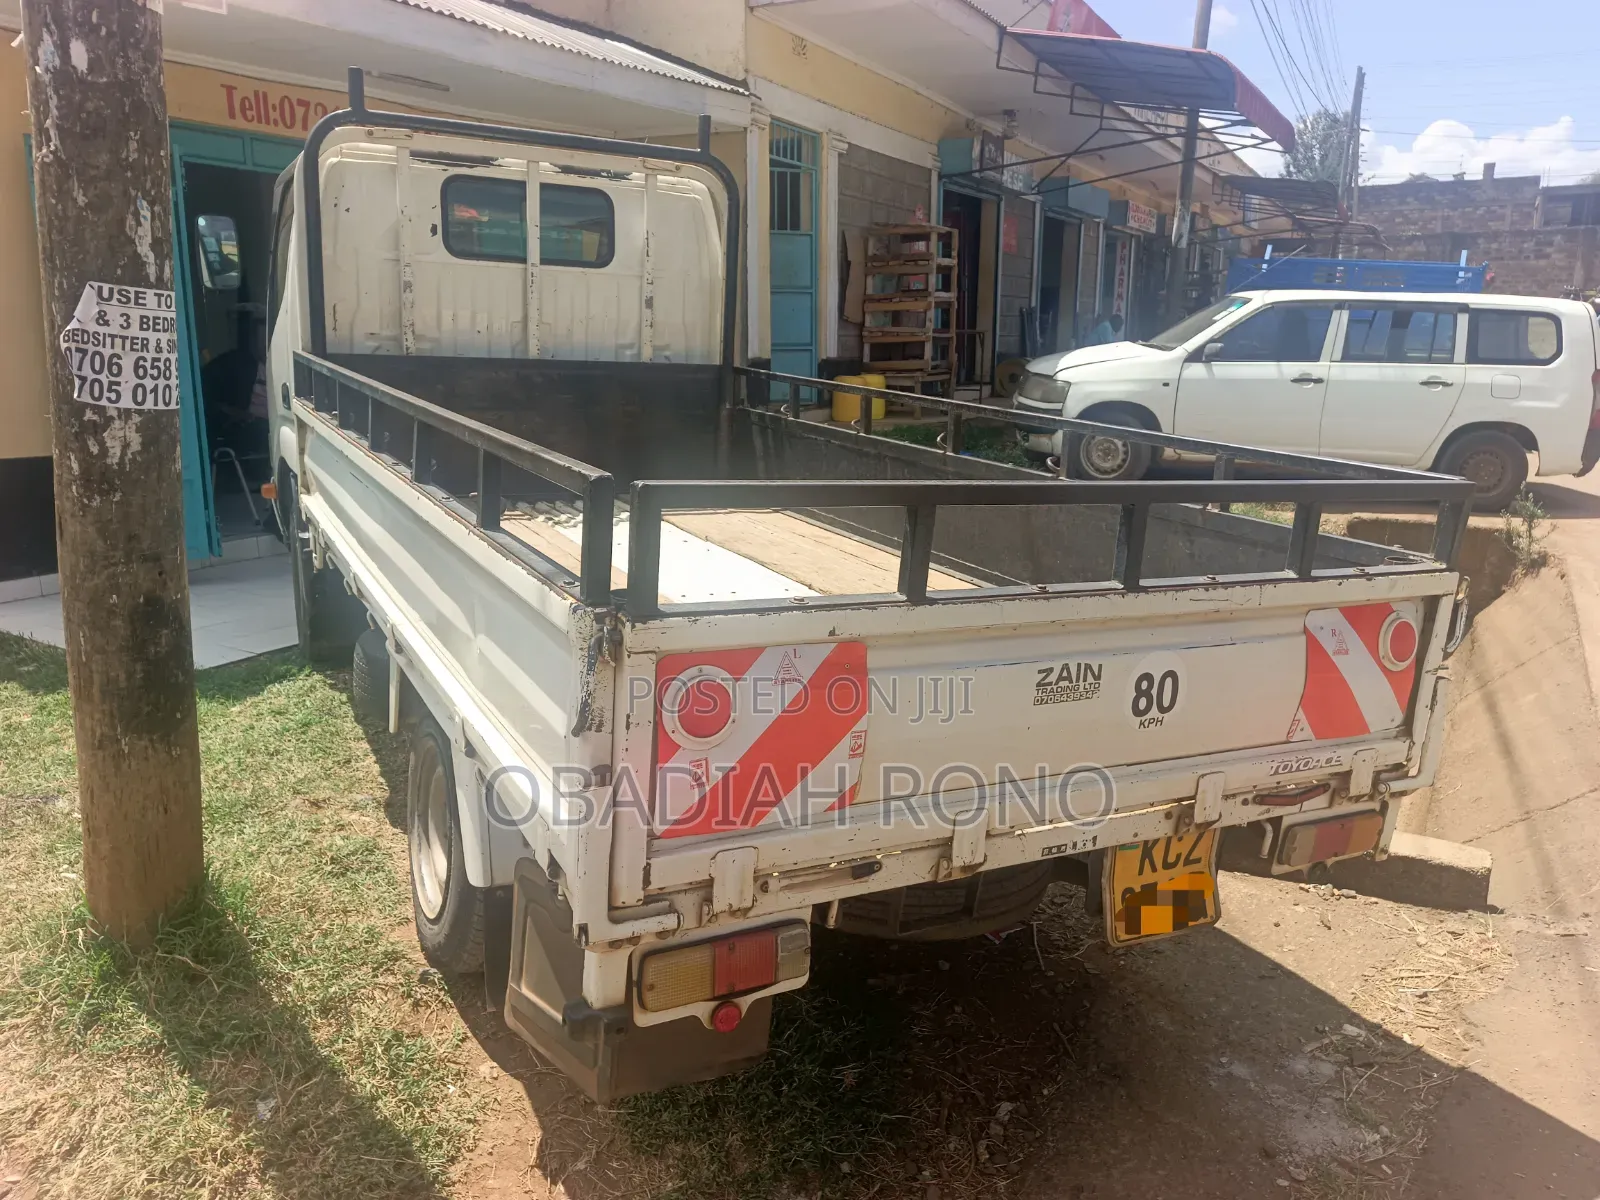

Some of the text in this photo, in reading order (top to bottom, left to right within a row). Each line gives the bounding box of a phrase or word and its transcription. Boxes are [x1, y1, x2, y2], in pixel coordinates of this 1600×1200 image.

[220, 84, 340, 132] Tell:072
[97, 285, 173, 309] USE TO
[95, 309, 111, 328] &
[119, 312, 132, 330] 3
[62, 327, 150, 353] BEDSITTER
[154, 338, 164, 354] &
[63, 346, 123, 378] 0706
[1035, 662, 1103, 688] ZAIN
[1035, 681, 1101, 696] TRADING LTD
[1131, 669, 1180, 718] 80
[1138, 716, 1165, 730] KPH
[1137, 832, 1206, 876] KCZ
